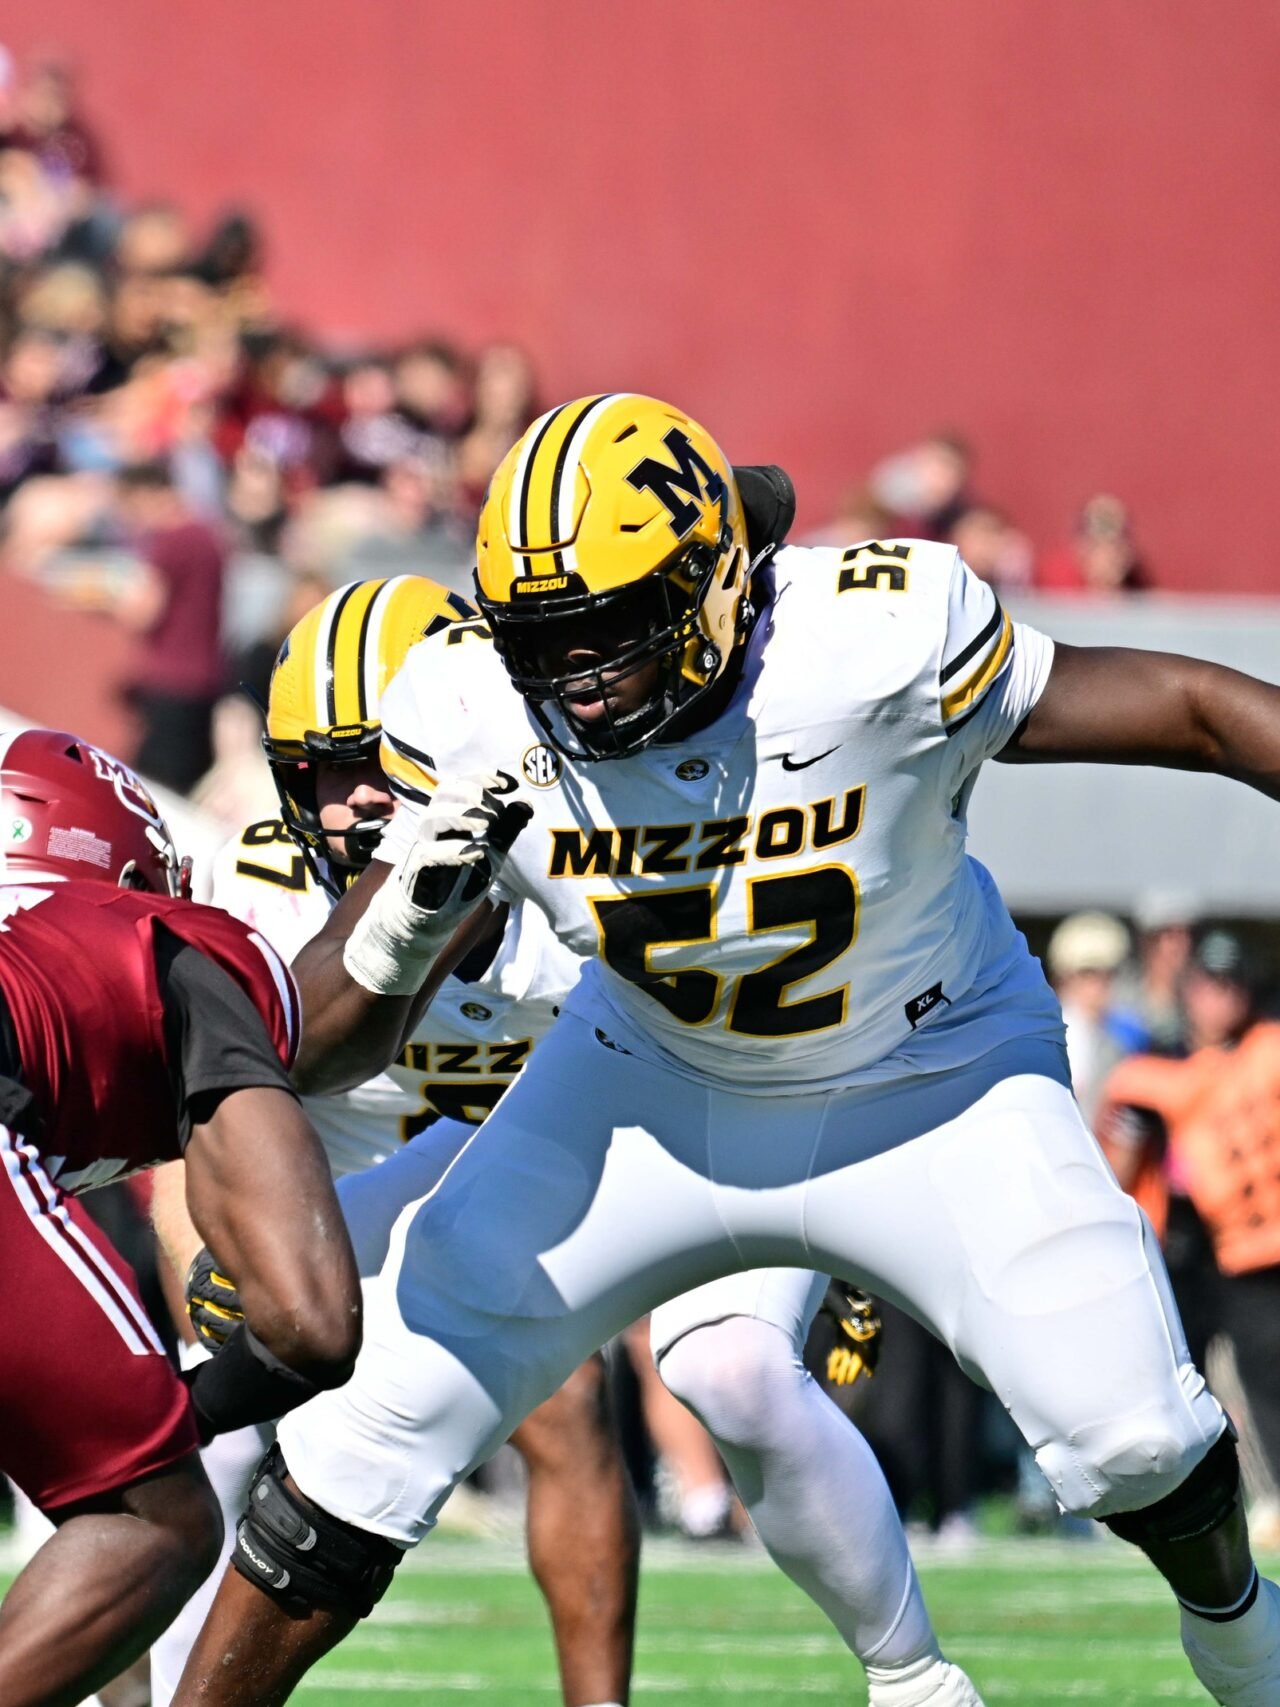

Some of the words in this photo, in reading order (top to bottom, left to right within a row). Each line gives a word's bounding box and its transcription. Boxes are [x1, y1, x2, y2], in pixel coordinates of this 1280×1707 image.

[624, 426, 724, 540] M
[516, 577, 568, 593] MIZZOU
[225, 818, 310, 893] 87
[548, 784, 867, 879] MIZZOU
[586, 862, 860, 1039] 52
[917, 994, 934, 1012] XL
[240, 1538, 274, 1574] DONJOY
